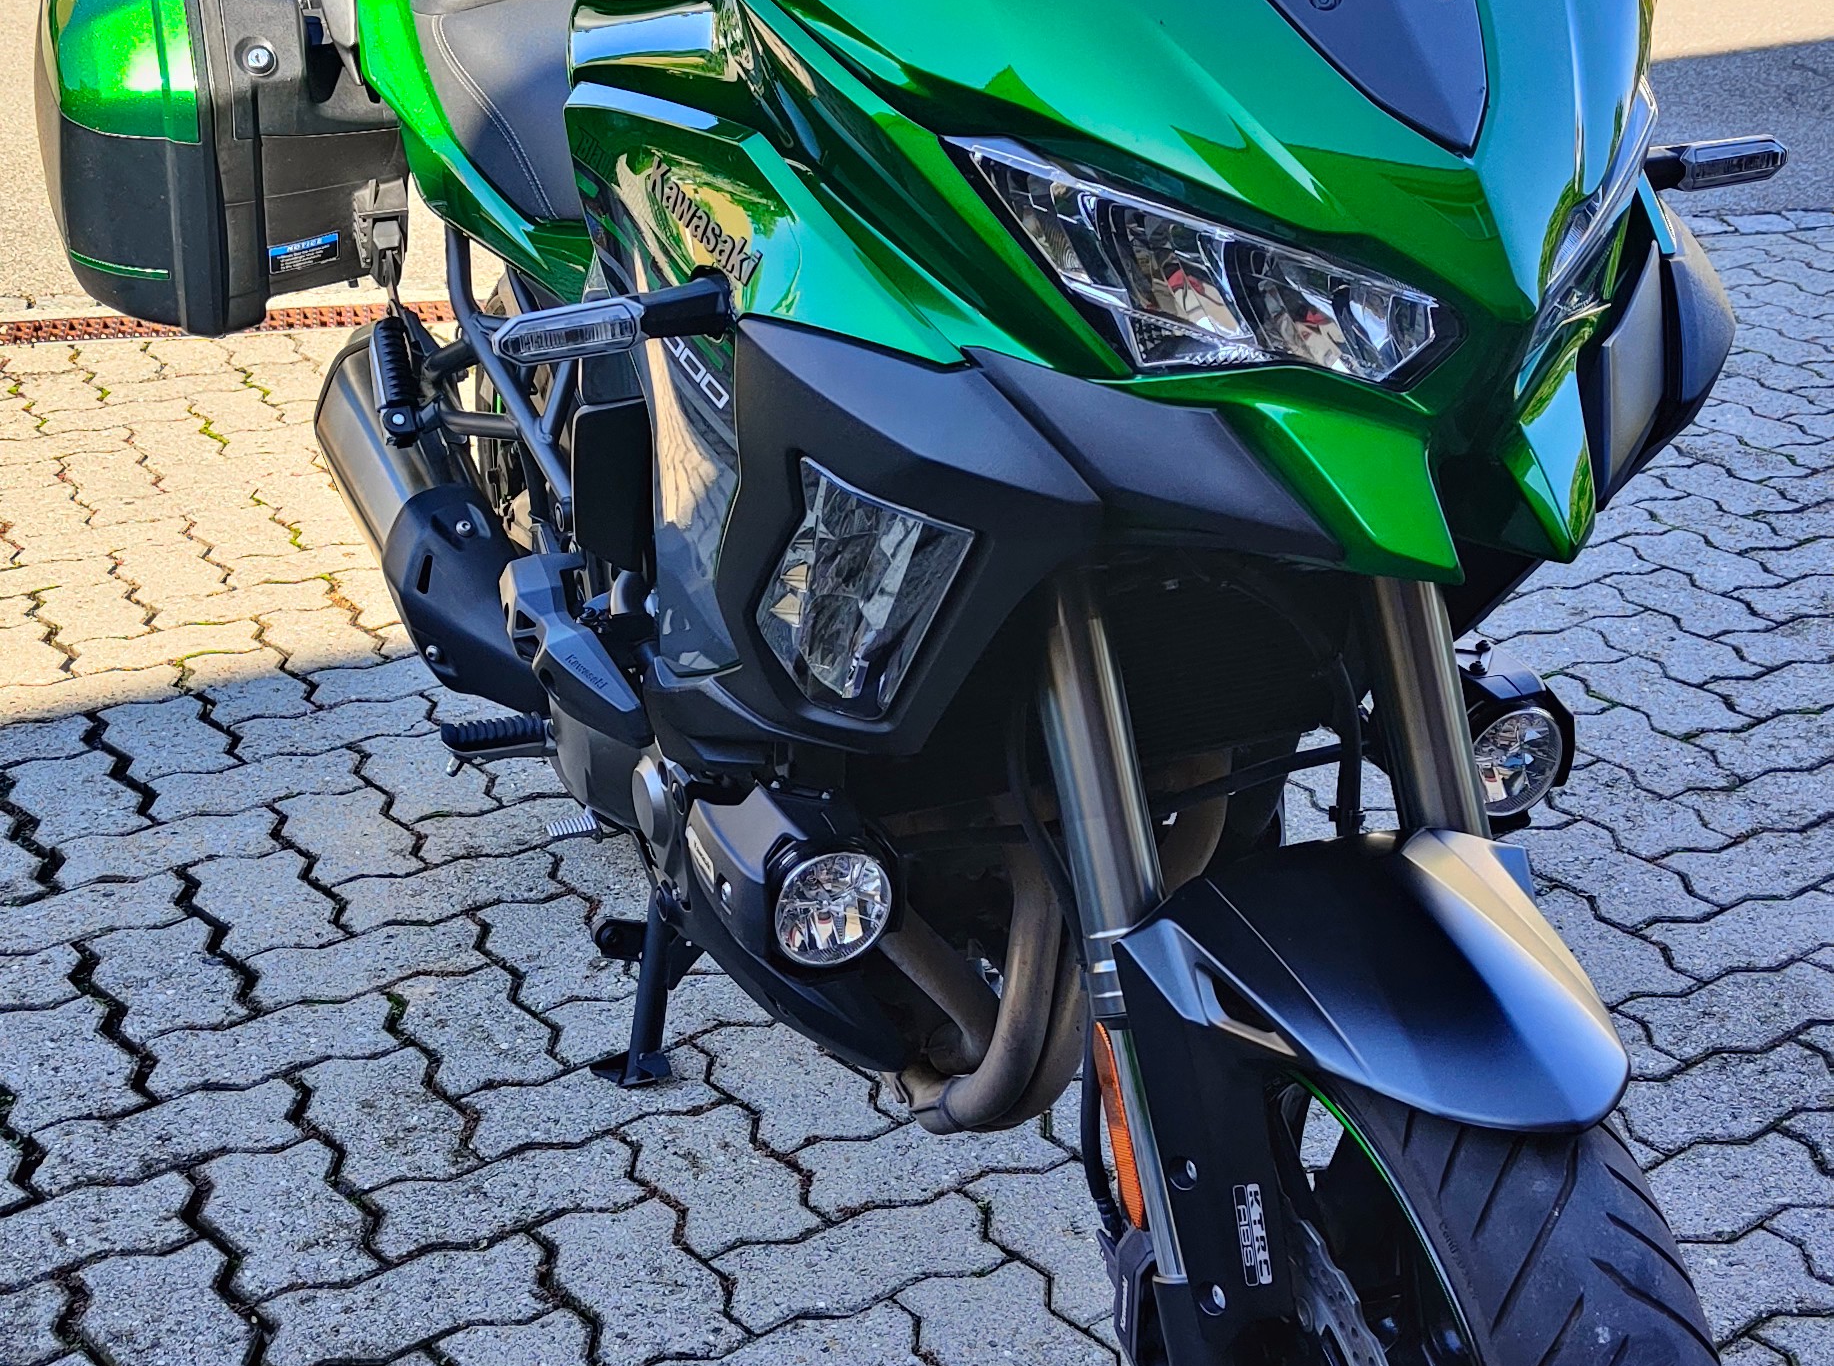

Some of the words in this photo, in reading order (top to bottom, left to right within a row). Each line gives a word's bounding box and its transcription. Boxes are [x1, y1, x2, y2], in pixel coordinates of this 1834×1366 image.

[648, 153, 764, 287] Kawasaki
[662, 335, 730, 410] 000
[1236, 1204, 1255, 1267] ABS
[1249, 1190, 1271, 1277] KTRC
